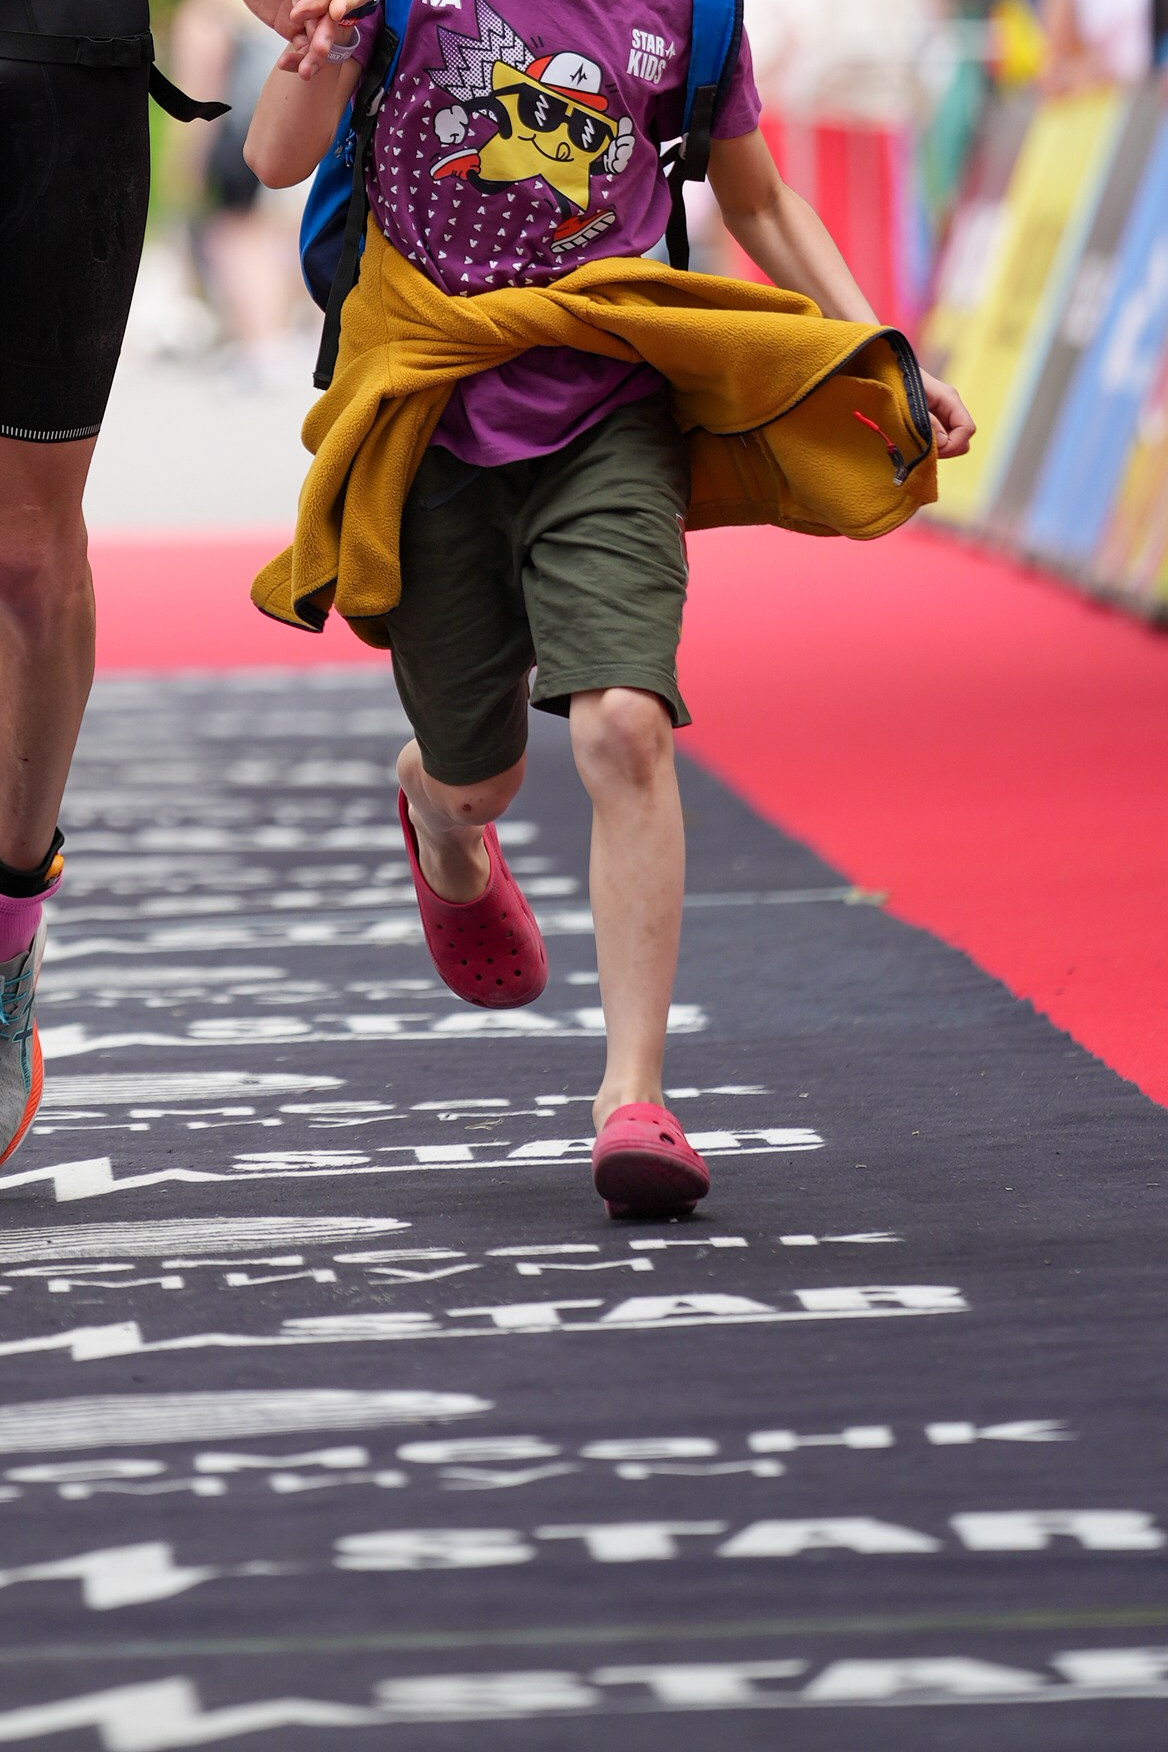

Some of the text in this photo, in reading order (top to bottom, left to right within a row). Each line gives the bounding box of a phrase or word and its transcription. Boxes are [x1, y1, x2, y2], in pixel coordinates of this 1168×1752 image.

[632, 28, 665, 57] STAR
[626, 48, 666, 85] KIDS
[281, 1284, 971, 1335] STAR
[334, 1510, 1165, 1570] STAR
